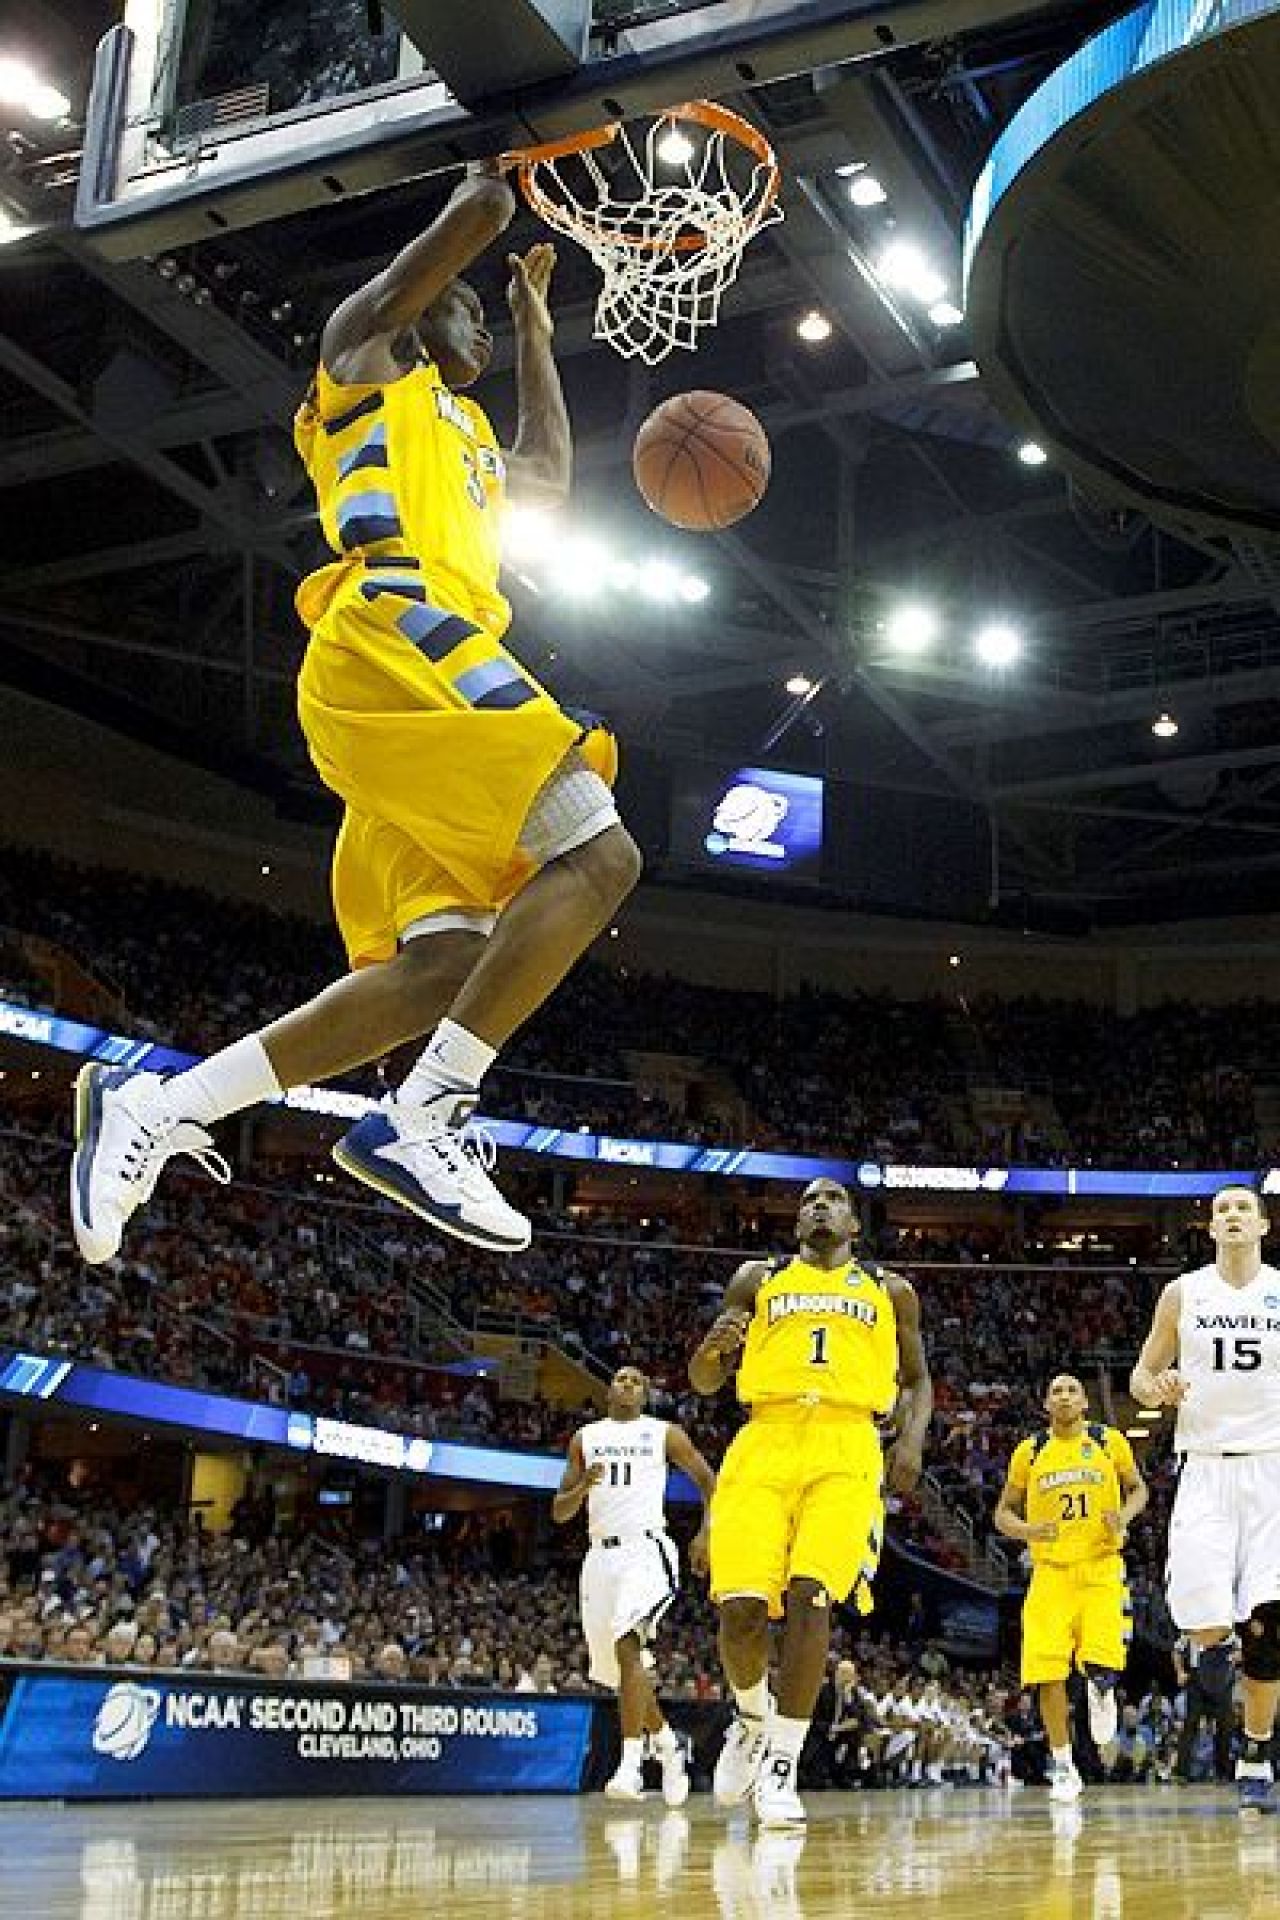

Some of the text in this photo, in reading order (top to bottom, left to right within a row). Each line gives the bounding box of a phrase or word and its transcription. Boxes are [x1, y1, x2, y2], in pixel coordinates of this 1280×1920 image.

[767, 1293, 877, 1327] MARQUETTE
[809, 1327, 829, 1365] 1
[1212, 1337, 1262, 1372] 15
[610, 1461, 632, 1486] 11
[1059, 1492, 1089, 1521] 21
[249, 1696, 346, 1731] SECOND
[349, 1702, 397, 1731] AND
[400, 1705, 458, 1735] THIRD
[461, 1706, 538, 1738] ROUNDS
[298, 1734, 442, 1763] CLEVELAND, OHIO
